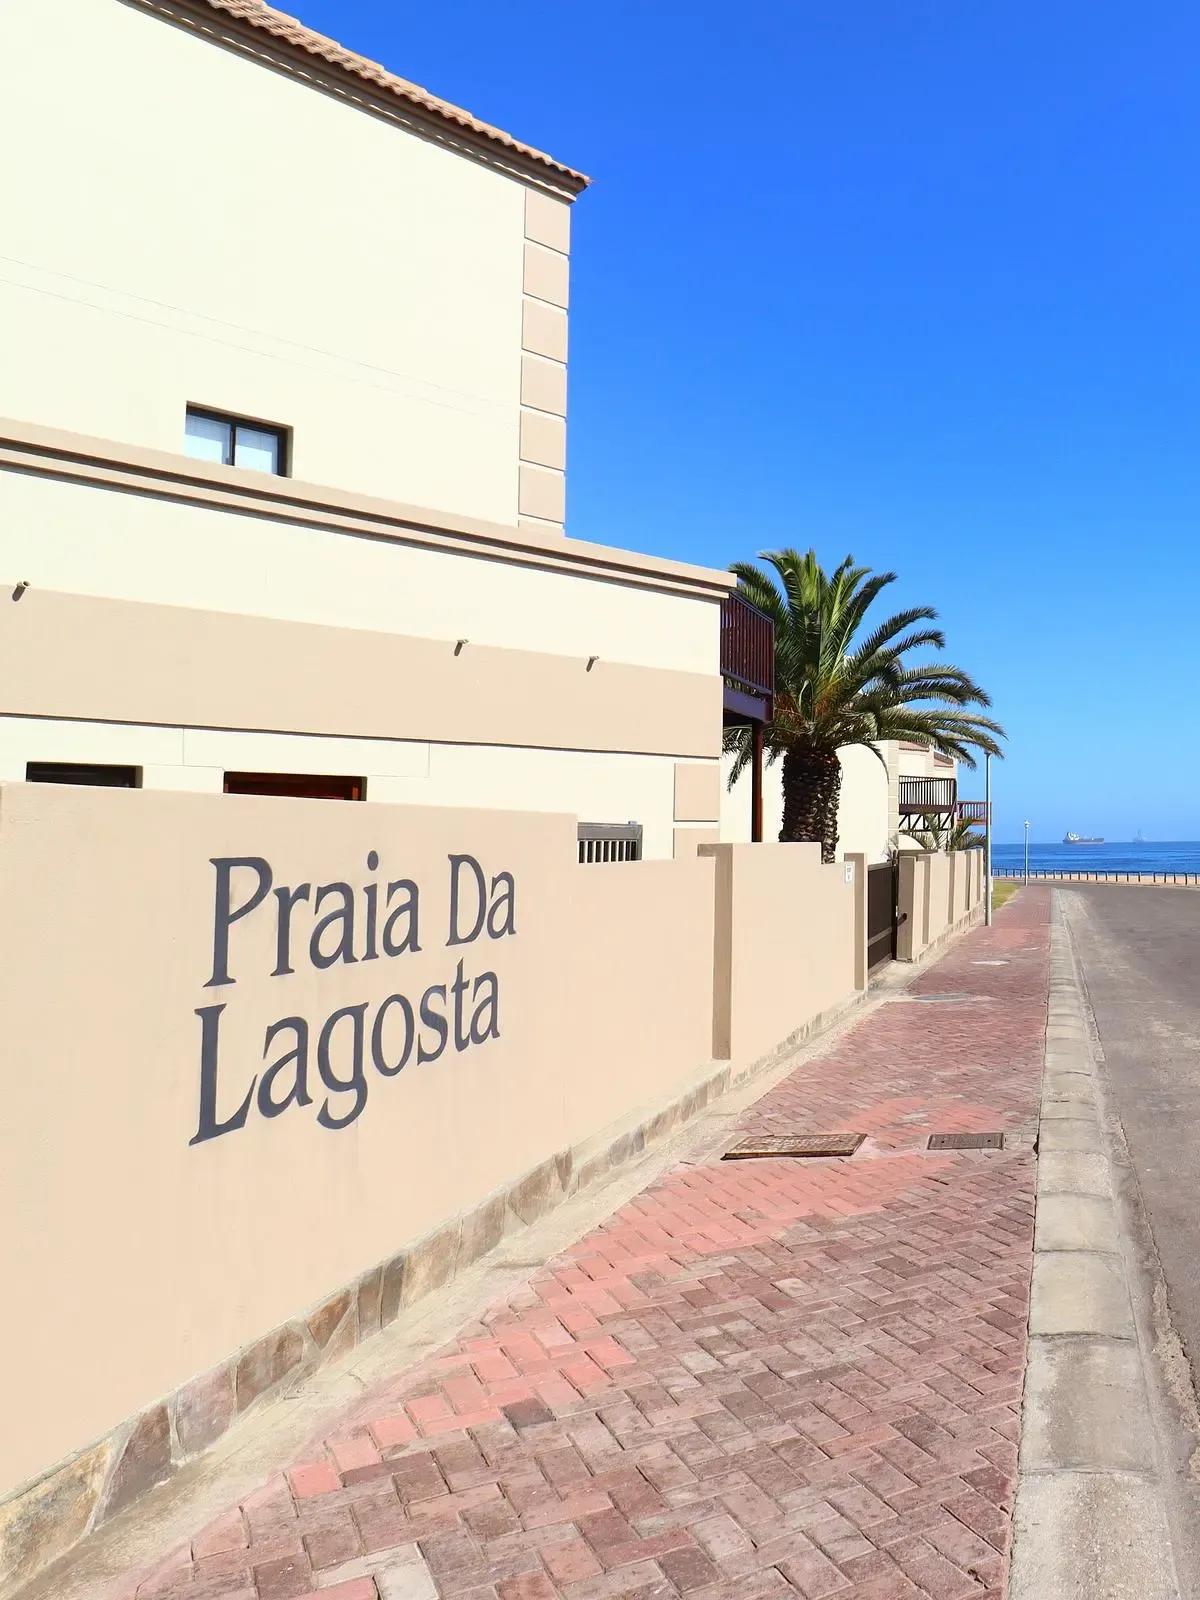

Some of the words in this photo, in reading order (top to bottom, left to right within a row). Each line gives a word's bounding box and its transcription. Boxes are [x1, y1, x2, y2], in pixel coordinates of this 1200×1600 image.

[203, 850, 422, 988] Praia
[445, 854, 517, 947] Da
[188, 957, 501, 1146] Lagosta
